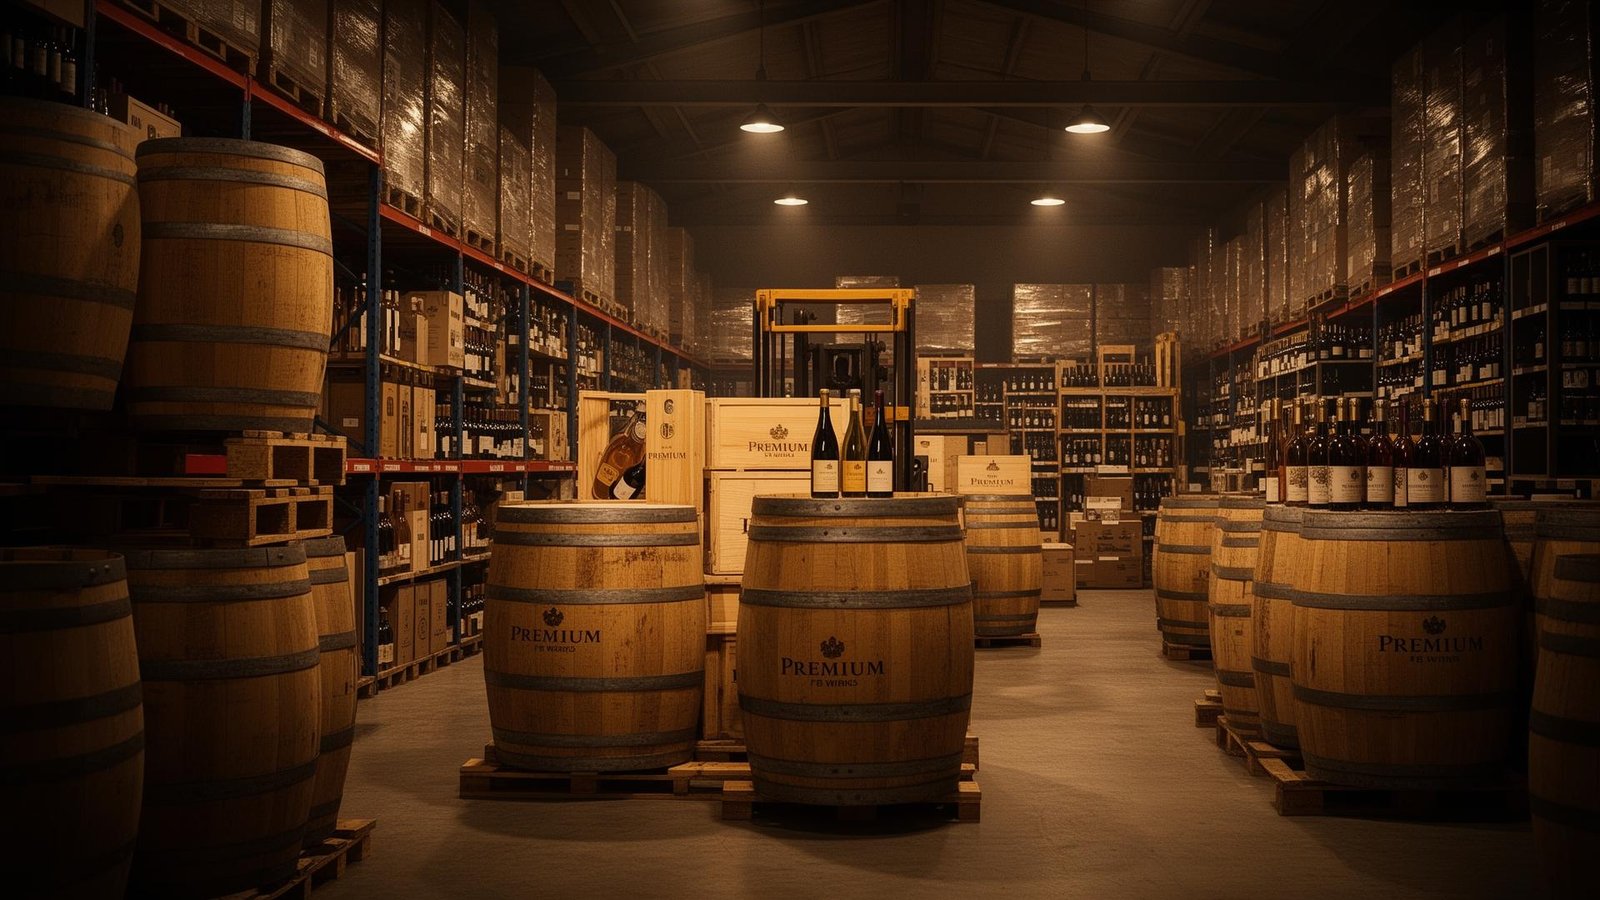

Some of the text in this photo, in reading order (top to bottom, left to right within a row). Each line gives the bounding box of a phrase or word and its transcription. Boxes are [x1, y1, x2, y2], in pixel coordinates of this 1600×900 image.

[748, 441, 809, 452] PREMIUM
[647, 452, 687, 460] PREMIUM
[510, 626, 601, 644] PREMIUM
[1378, 634, 1484, 653] PREMIUM
[780, 657, 886, 677] PREMIUM
